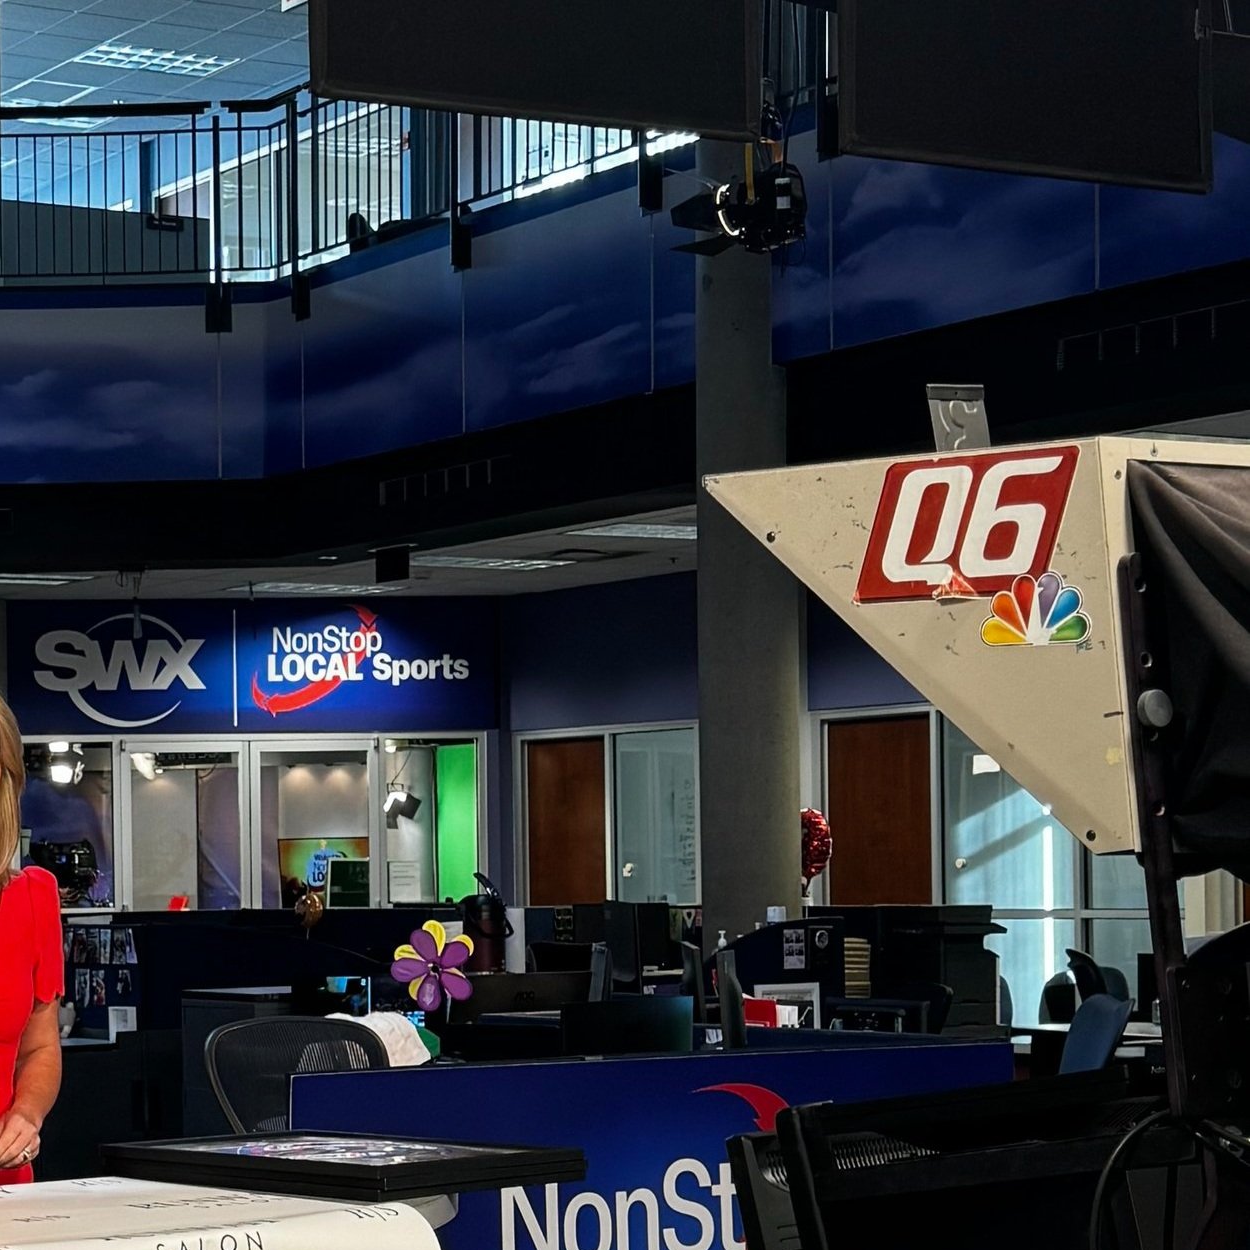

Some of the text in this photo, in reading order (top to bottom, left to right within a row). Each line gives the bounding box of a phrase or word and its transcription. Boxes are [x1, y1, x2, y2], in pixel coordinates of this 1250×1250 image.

[271, 625, 383, 658] NonStop
[33, 629, 208, 693] SWX
[267, 652, 470, 686] LOCAL Sports
